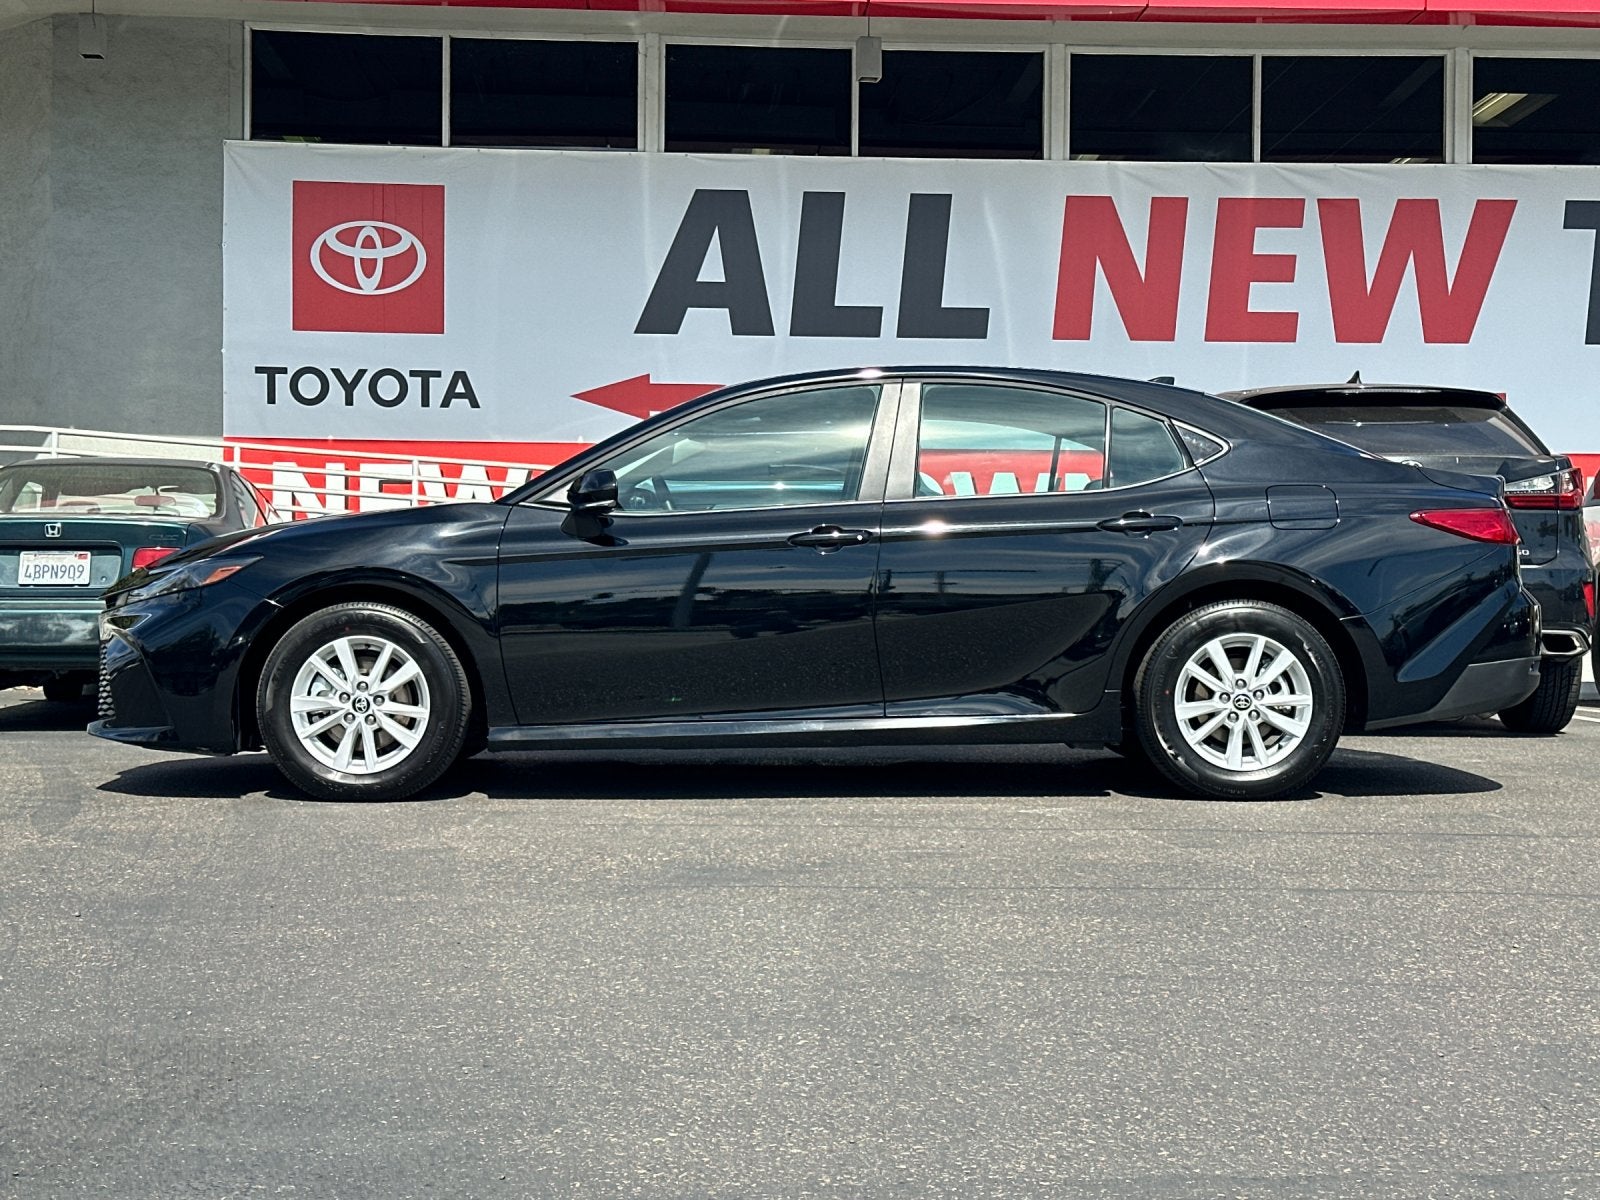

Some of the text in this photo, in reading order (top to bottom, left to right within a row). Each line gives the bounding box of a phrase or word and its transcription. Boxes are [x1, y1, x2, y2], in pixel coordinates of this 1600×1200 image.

[634, 188, 990, 339] ALL
[1052, 195, 1518, 343] NEW
[254, 366, 480, 408] TOYOTA
